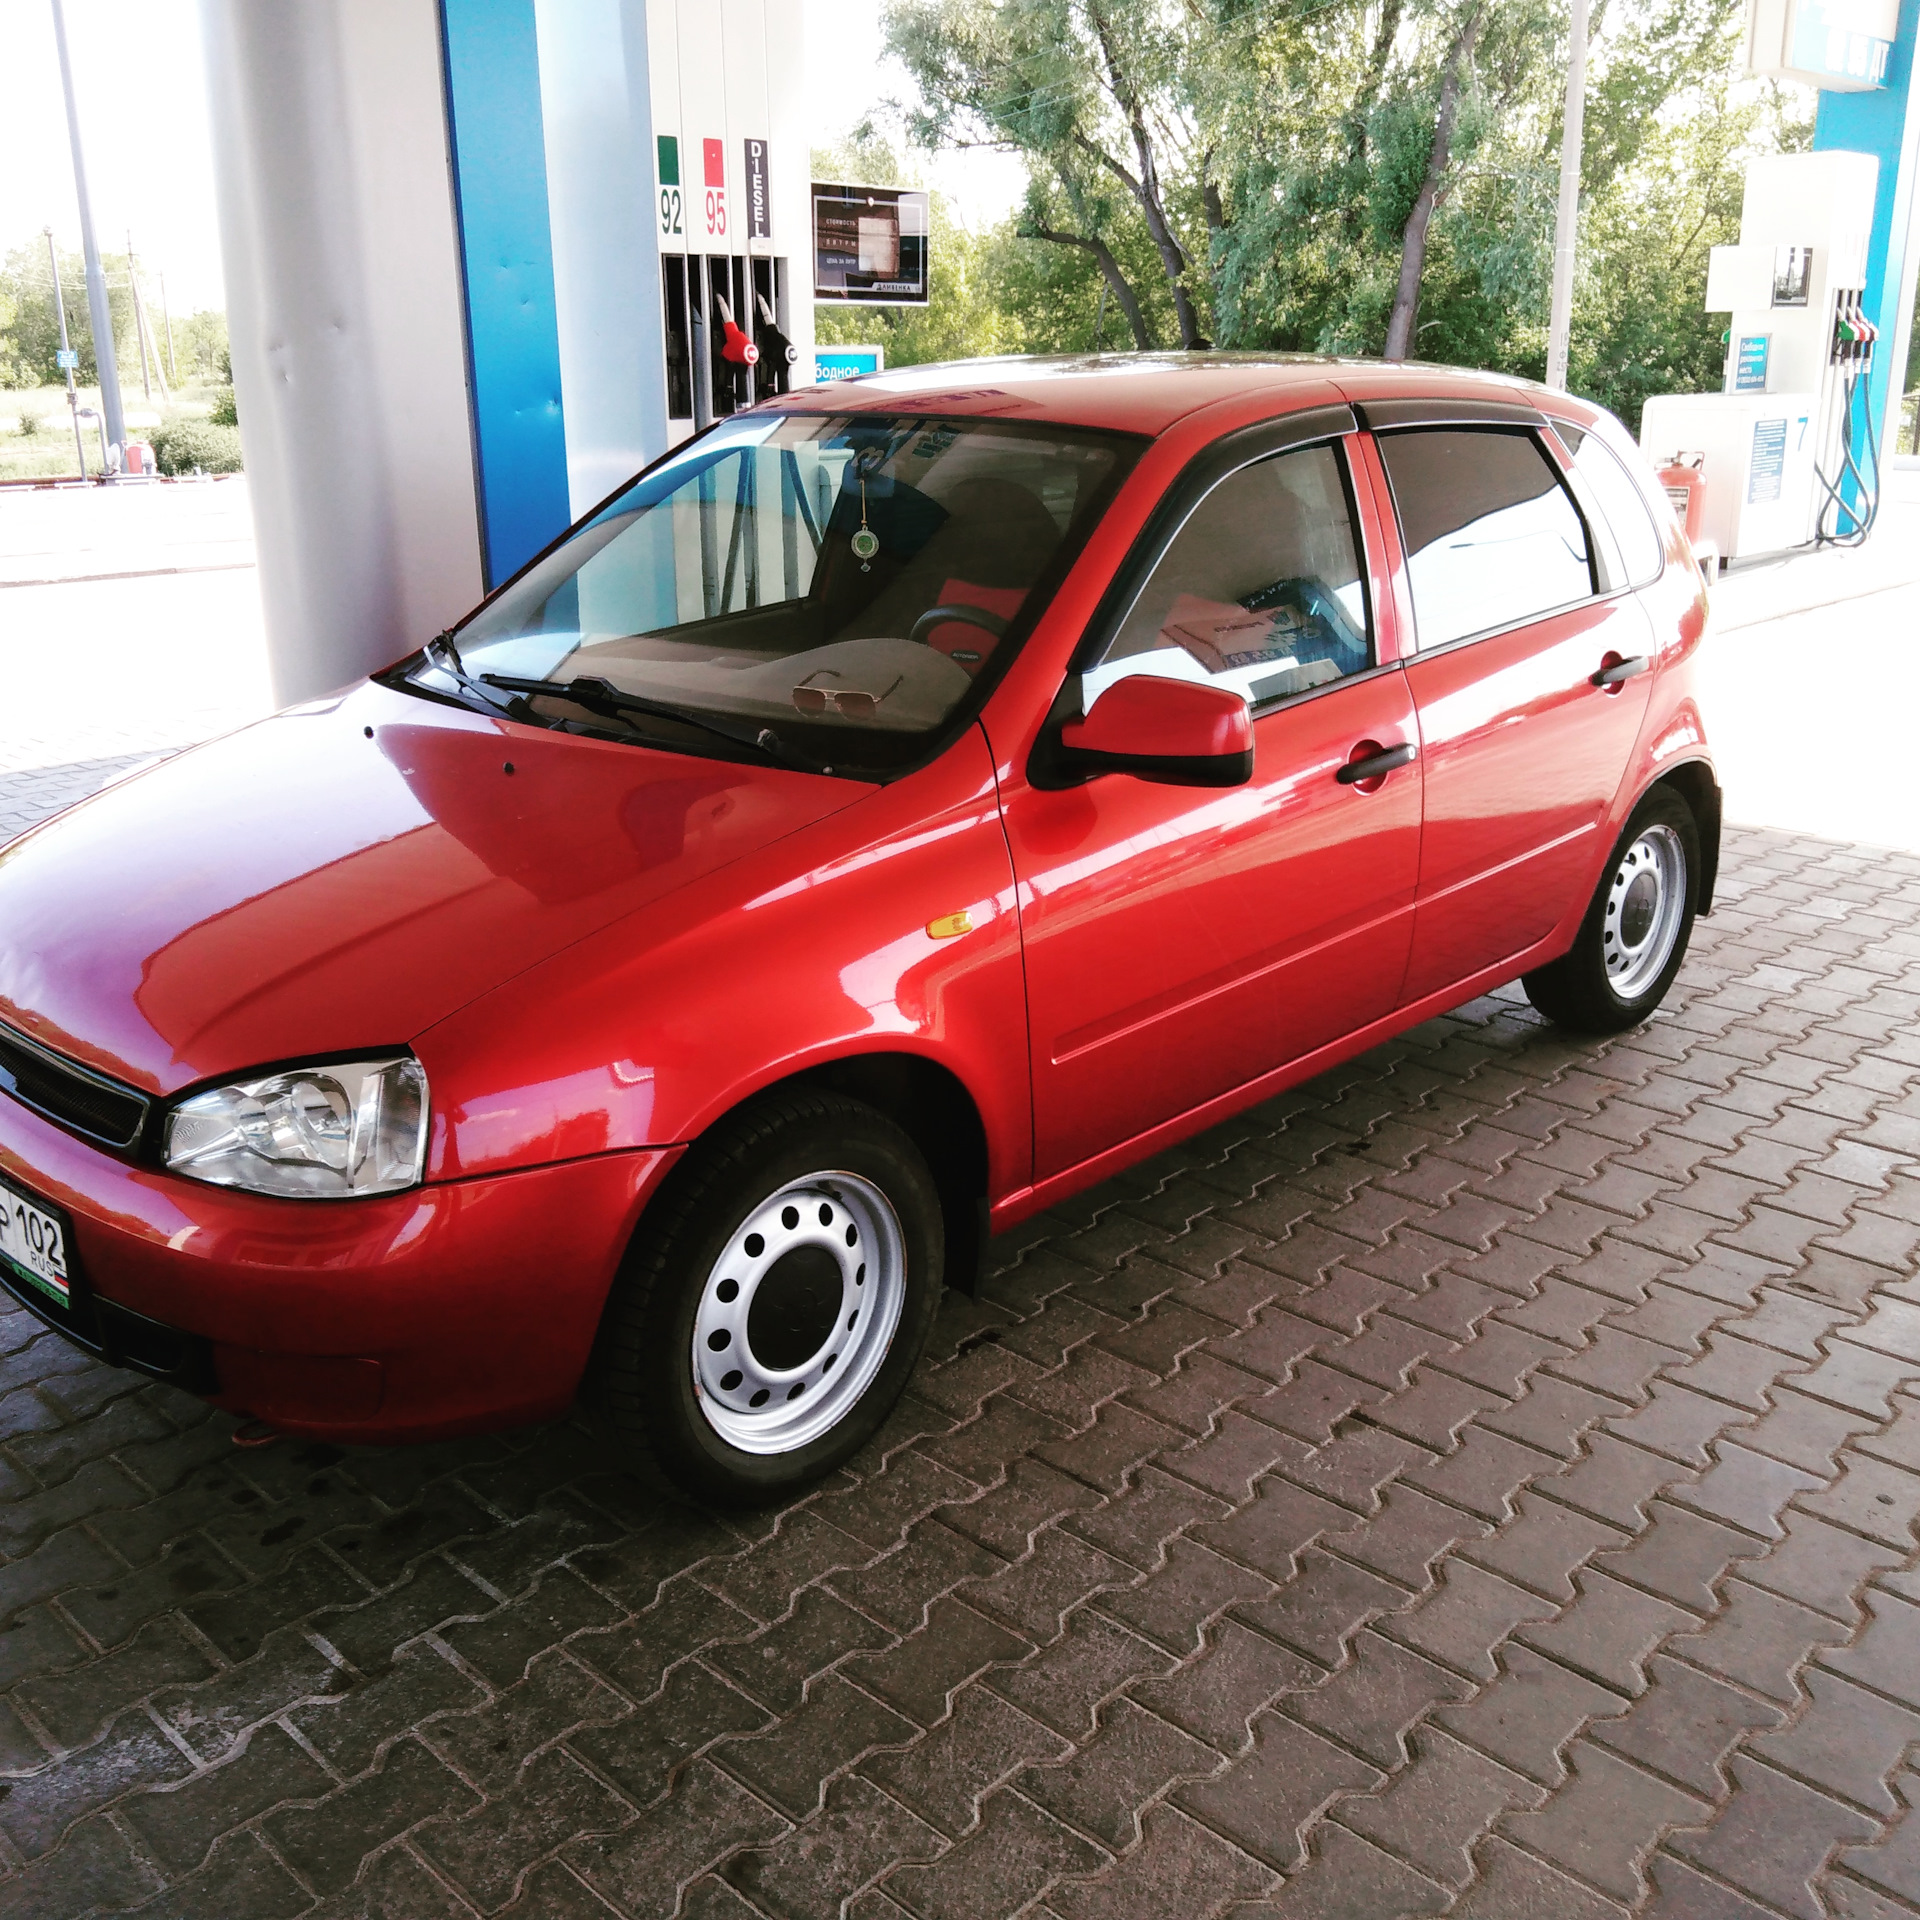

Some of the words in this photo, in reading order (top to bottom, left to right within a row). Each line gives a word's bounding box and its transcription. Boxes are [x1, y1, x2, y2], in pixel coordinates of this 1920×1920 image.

[660, 188, 682, 235] 92
[750, 141, 765, 238] DIESEL
[705, 190, 726, 236] 95
[1797, 416, 1809, 452] 7
[16, 1204, 61, 1266] 102
[30, 1250, 55, 1278] RUS
